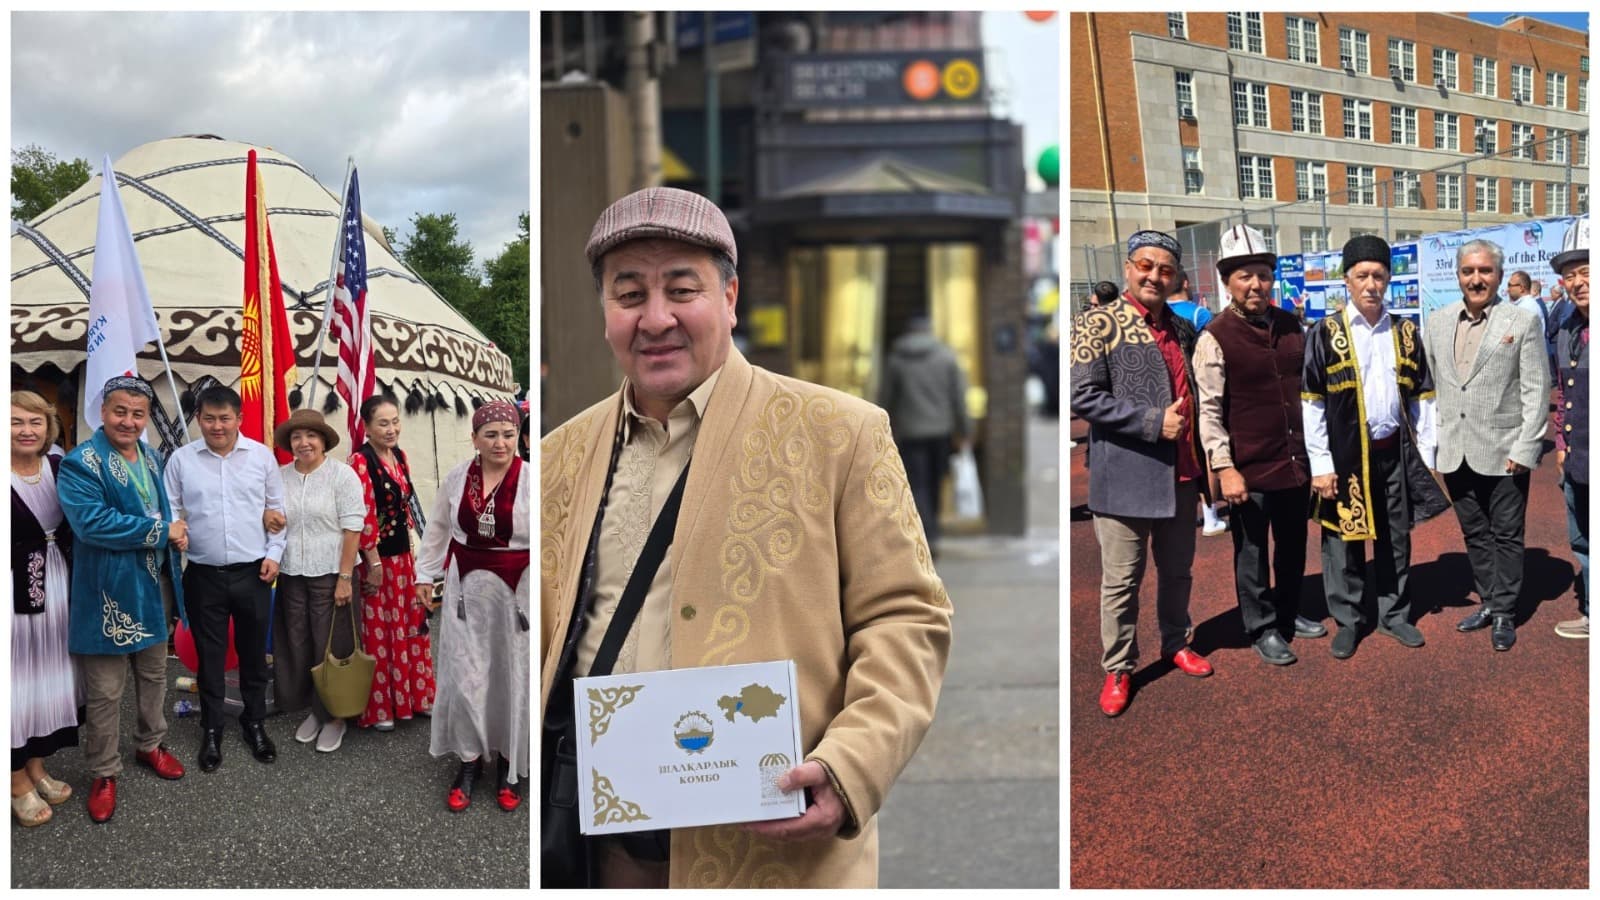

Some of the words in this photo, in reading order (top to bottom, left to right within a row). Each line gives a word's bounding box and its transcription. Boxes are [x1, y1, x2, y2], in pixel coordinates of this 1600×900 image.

[1435, 258, 1453, 270] 33rd
[1508, 253, 1519, 264] of
[1521, 251, 1536, 263] the
[679, 773, 720, 784] КОМБО
